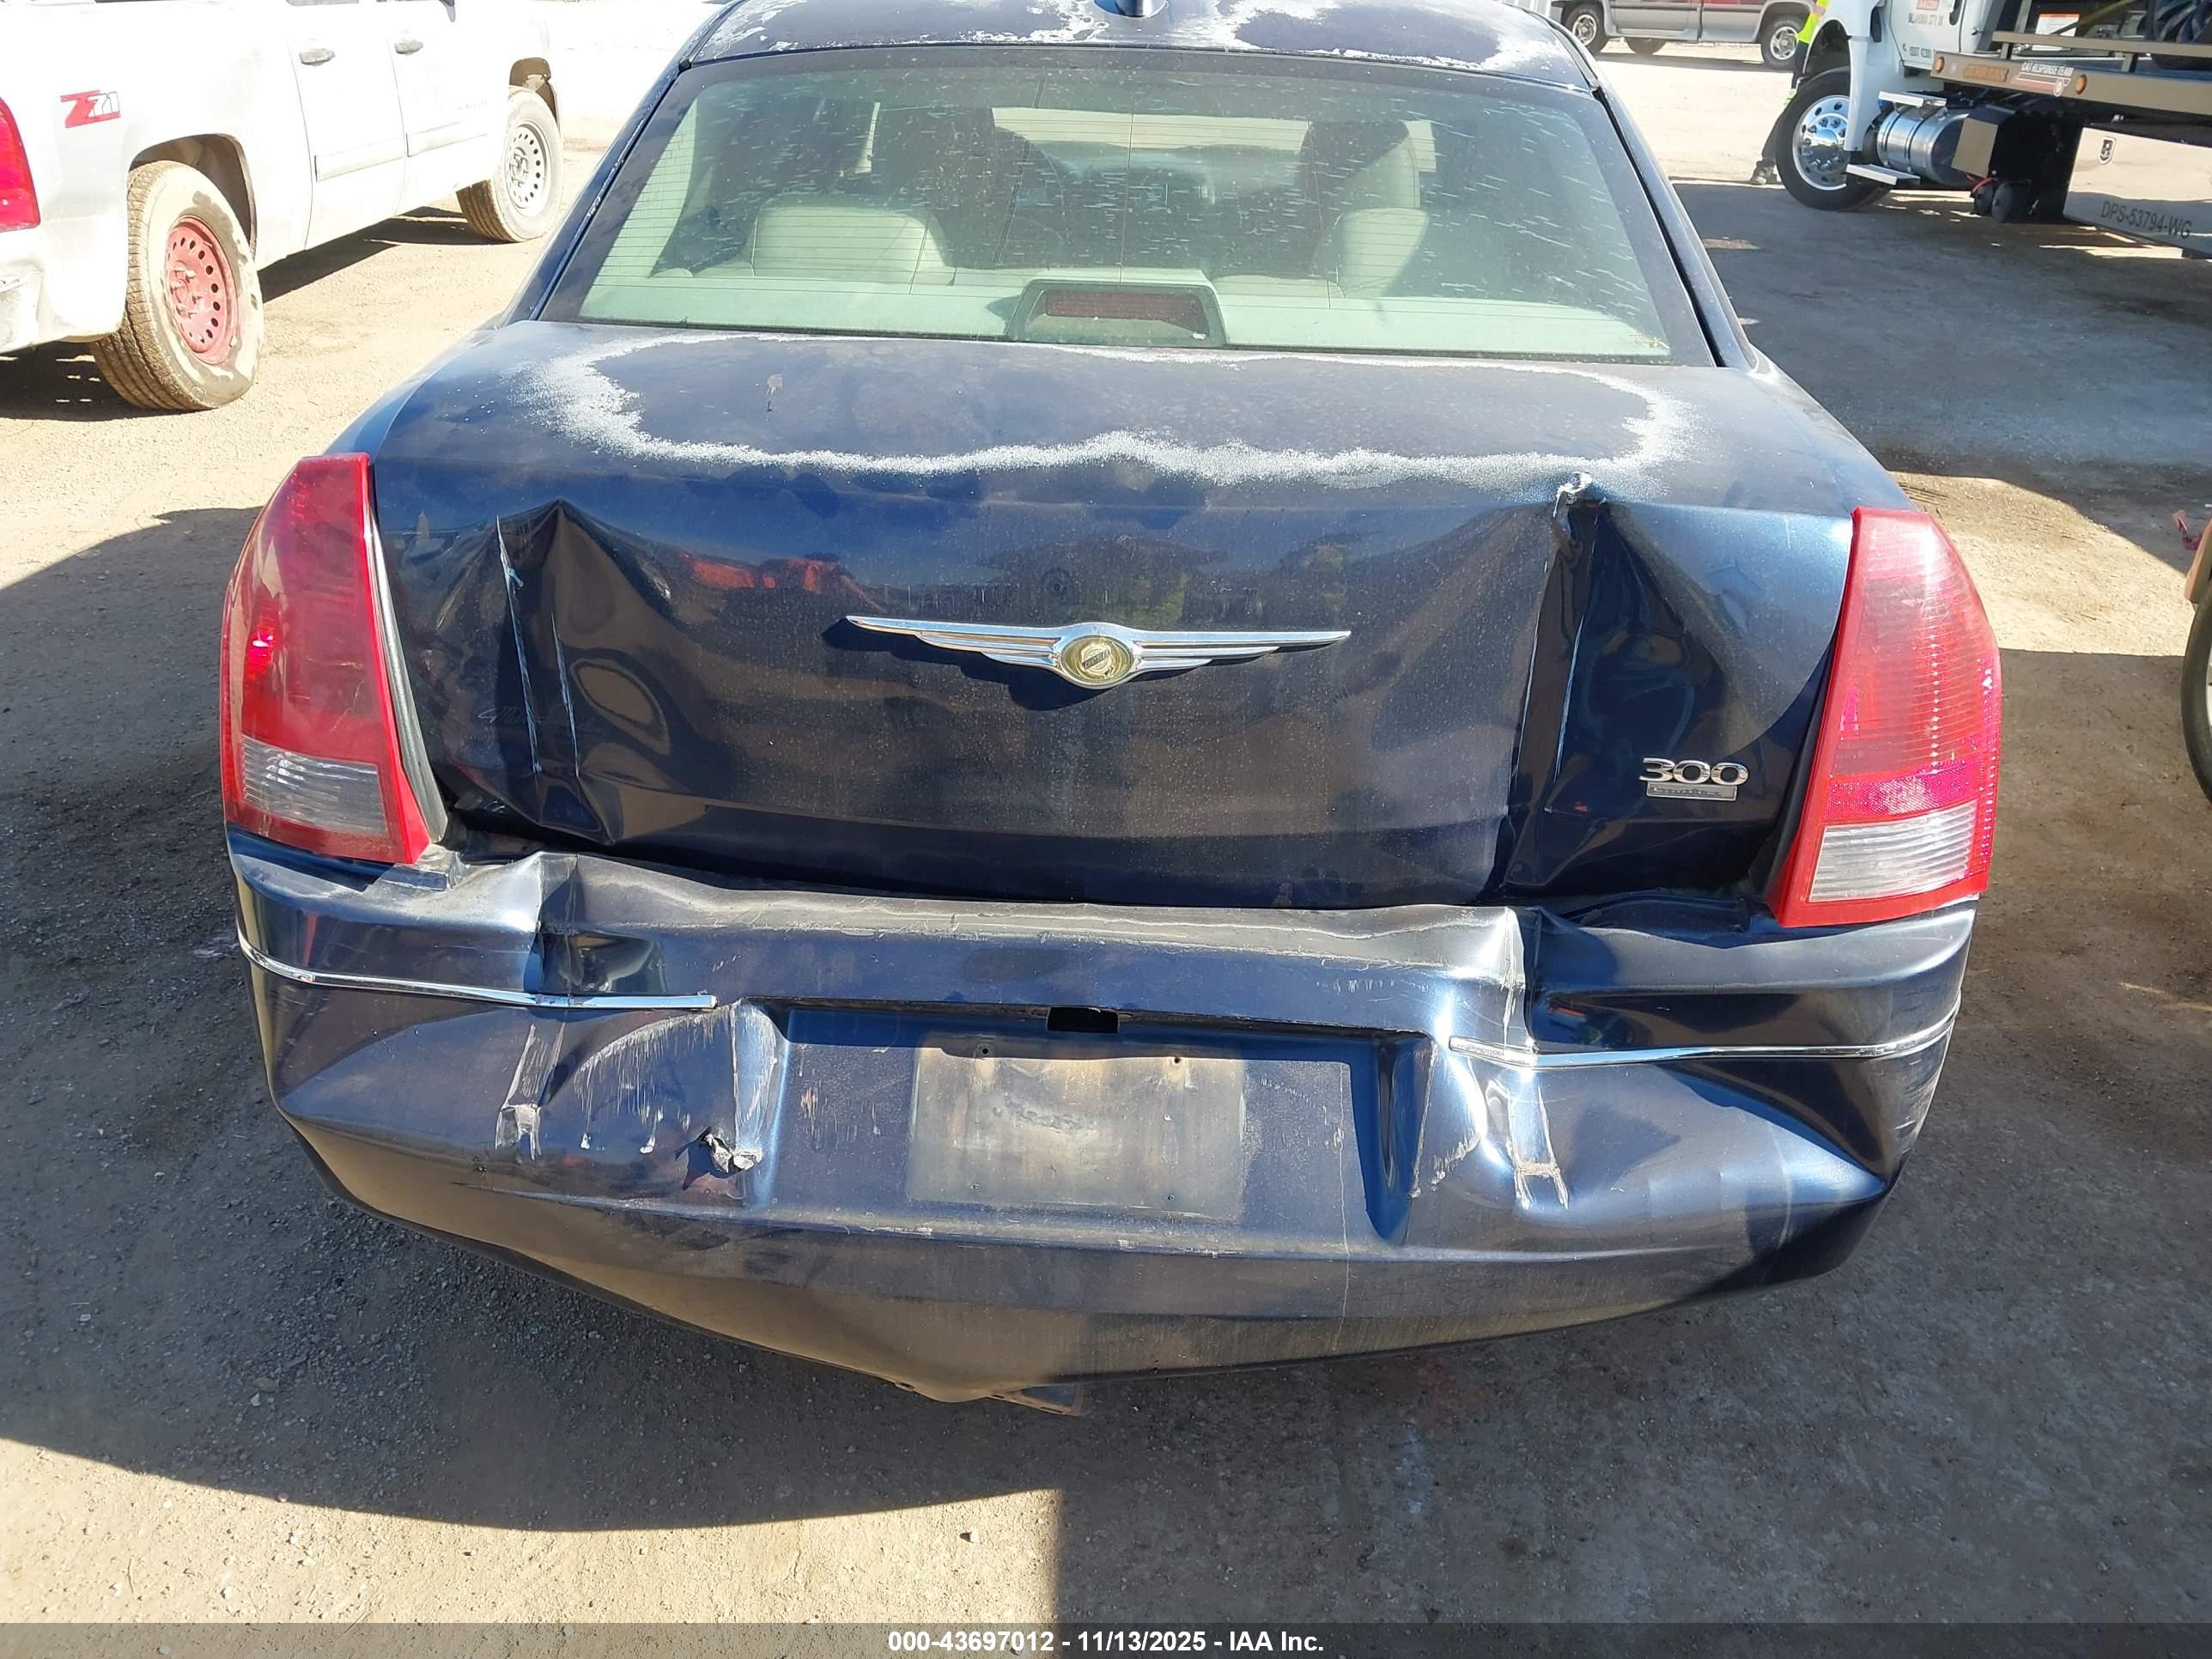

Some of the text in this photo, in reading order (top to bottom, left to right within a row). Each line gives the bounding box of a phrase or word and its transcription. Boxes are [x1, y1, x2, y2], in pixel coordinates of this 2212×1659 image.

[60, 89, 121, 128] Z71
[2101, 200, 2192, 239] DPS-53794-WG
[1638, 757, 1749, 786] 300
